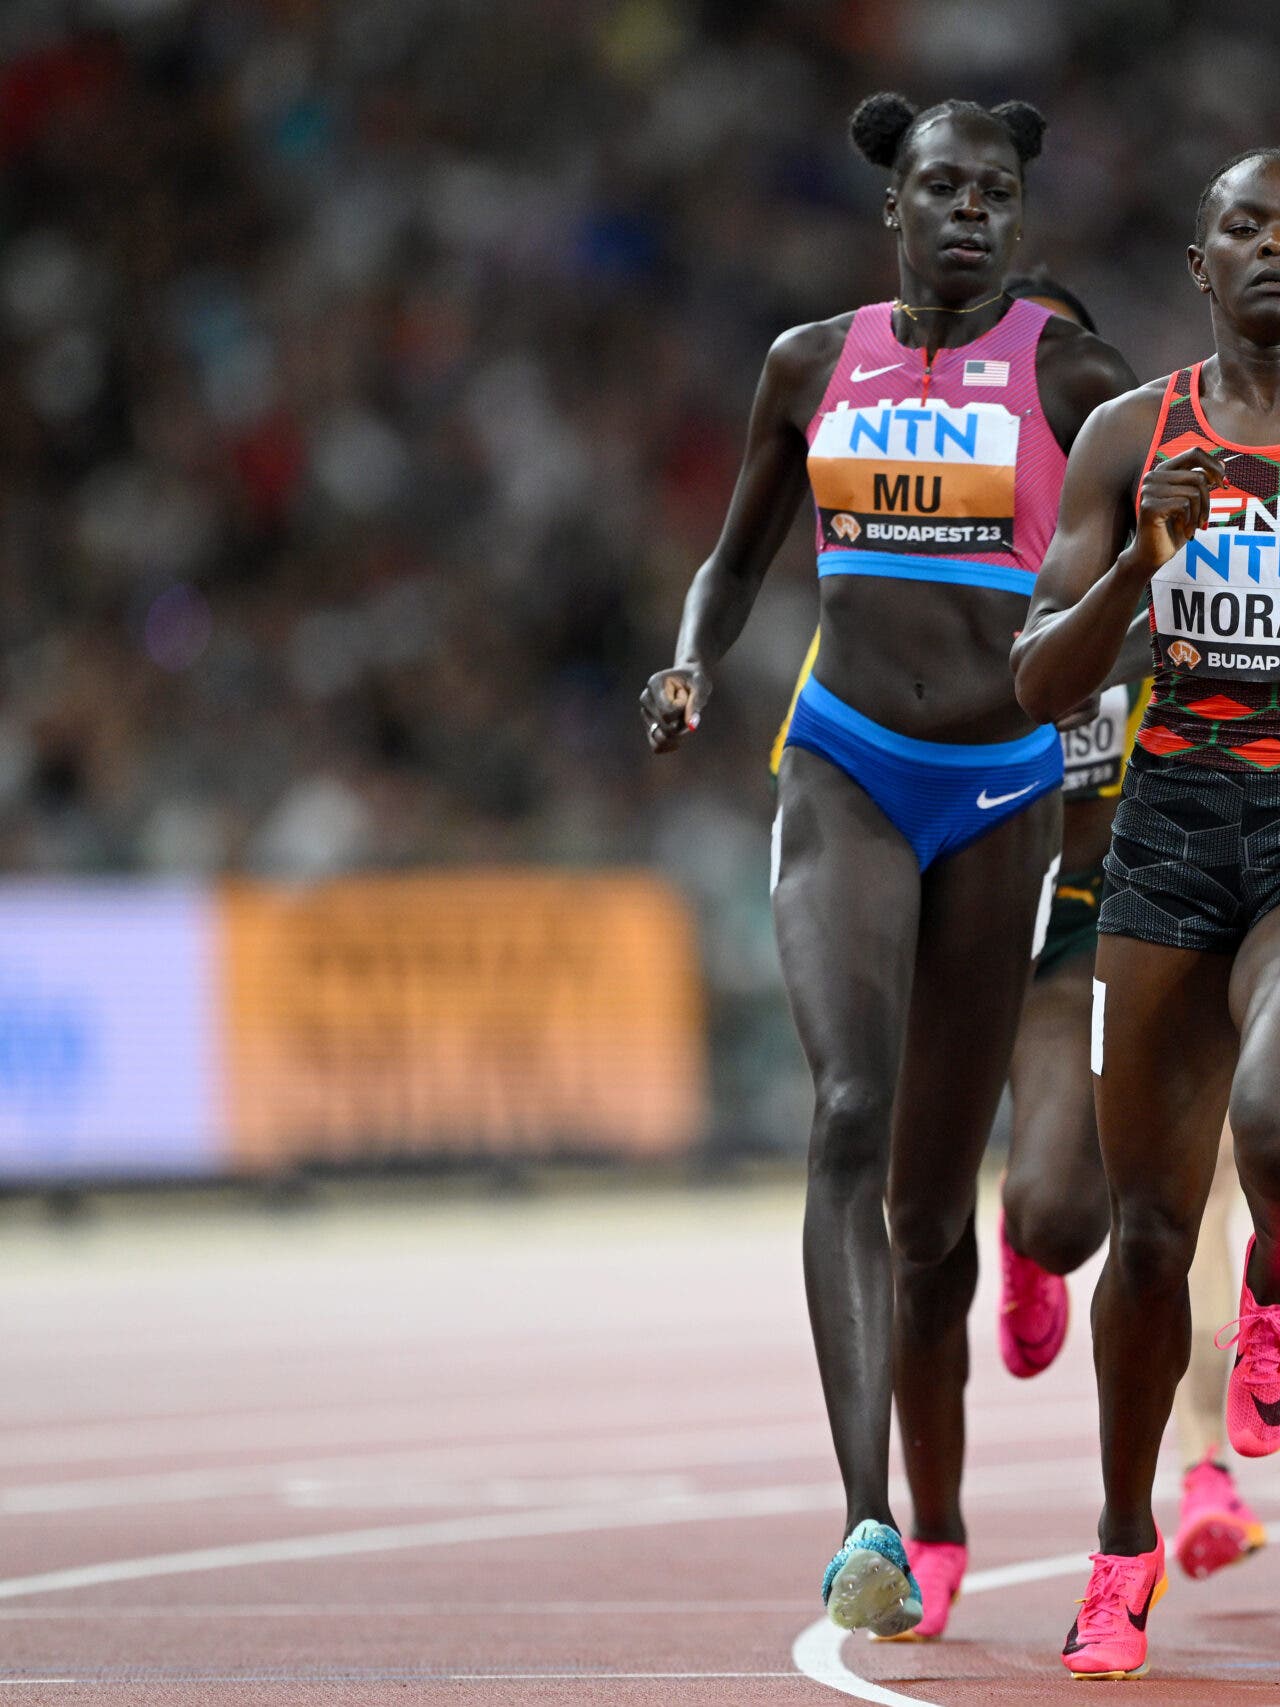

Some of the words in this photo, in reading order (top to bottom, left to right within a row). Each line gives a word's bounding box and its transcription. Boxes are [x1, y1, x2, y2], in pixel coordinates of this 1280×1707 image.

[850, 410, 978, 459] NTN
[873, 473, 942, 513] MU
[866, 523, 976, 543] BUDAPEST
[977, 526, 1001, 541] 23
